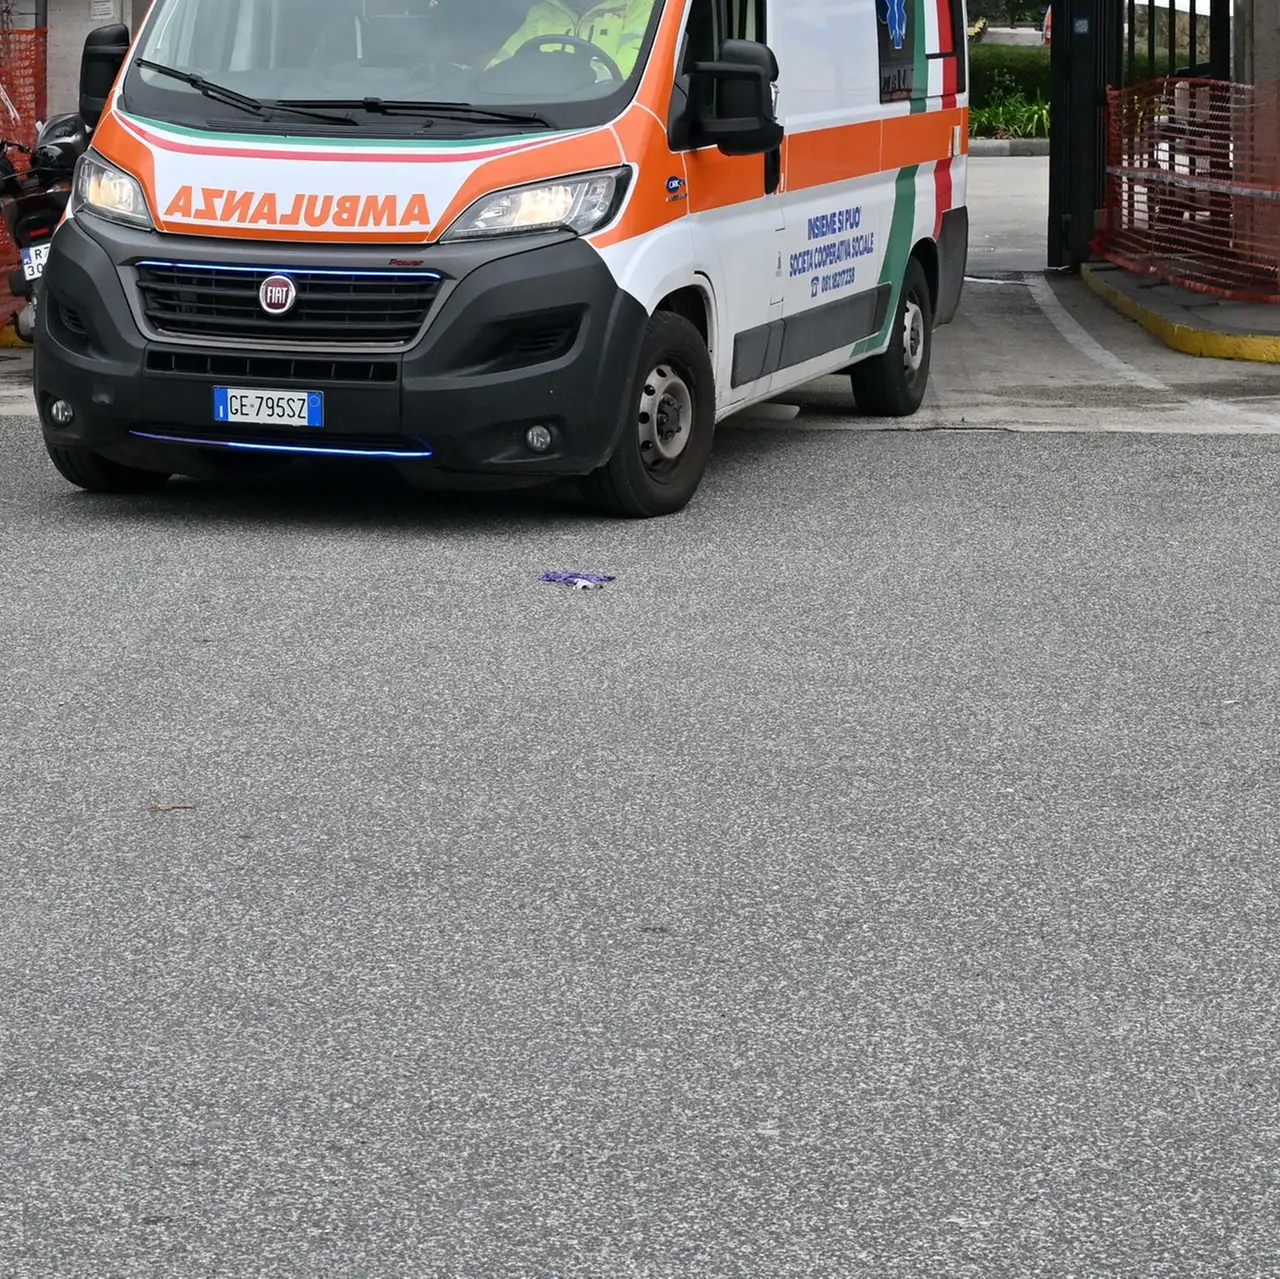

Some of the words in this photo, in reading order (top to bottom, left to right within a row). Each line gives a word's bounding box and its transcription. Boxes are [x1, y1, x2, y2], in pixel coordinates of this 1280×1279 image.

[807, 212, 837, 240] INSIEME
[837, 210, 844, 233] SI
[388, 258, 424, 267] Power
[267, 286, 288, 303] FIAT
